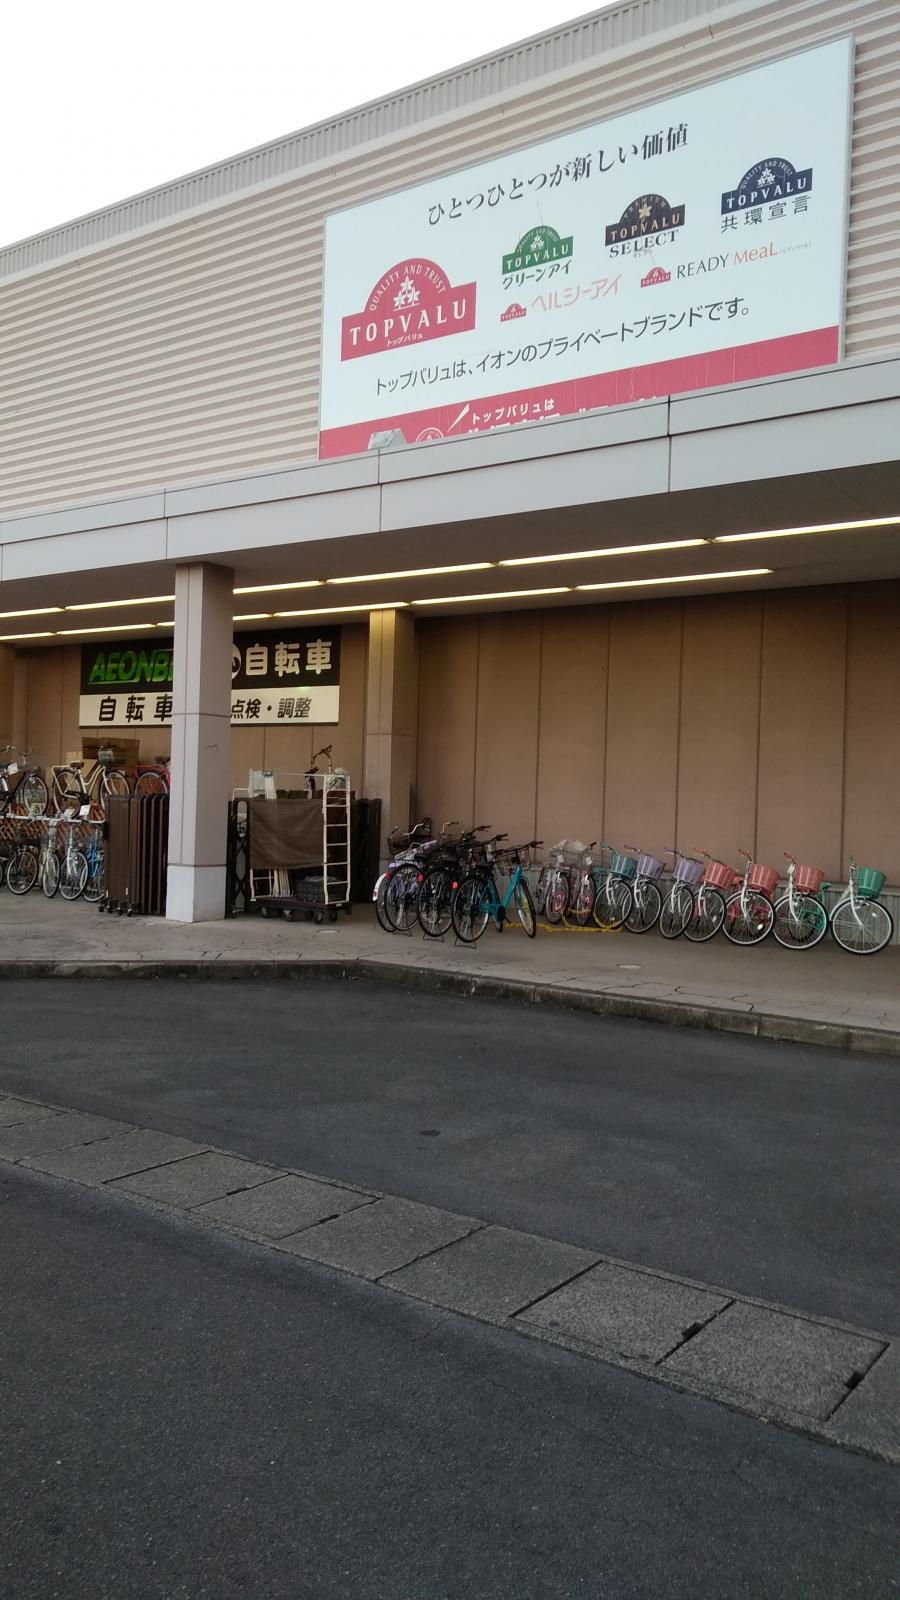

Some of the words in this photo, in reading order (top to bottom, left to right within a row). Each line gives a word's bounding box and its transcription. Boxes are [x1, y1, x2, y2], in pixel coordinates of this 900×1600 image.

[428, 123, 689, 225] ひとつひとつが新しい価値
[727, 177, 807, 209] TOPVALU
[611, 213, 680, 242] TOPVALU
[720, 194, 812, 234] 共環宣言
[506, 243, 569, 270] TOPVALU
[609, 229, 679, 258] SELECT
[502, 259, 573, 291] グリーンアイ
[677, 253, 730, 279] READY
[369, 269, 400, 311] QUALITY
[404, 264, 422, 275] AND
[424, 267, 446, 294] TRUST
[531, 273, 623, 311] ヘルシーアイ
[349, 299, 466, 346] TOPVALU
[376, 297, 749, 396] トップバリュは、イオンのプライベートブランドです。
[387, 333, 423, 347] トップバリュ
[472, 398, 555, 425] トップバリュは
[98, 693, 173, 723] 自転車
